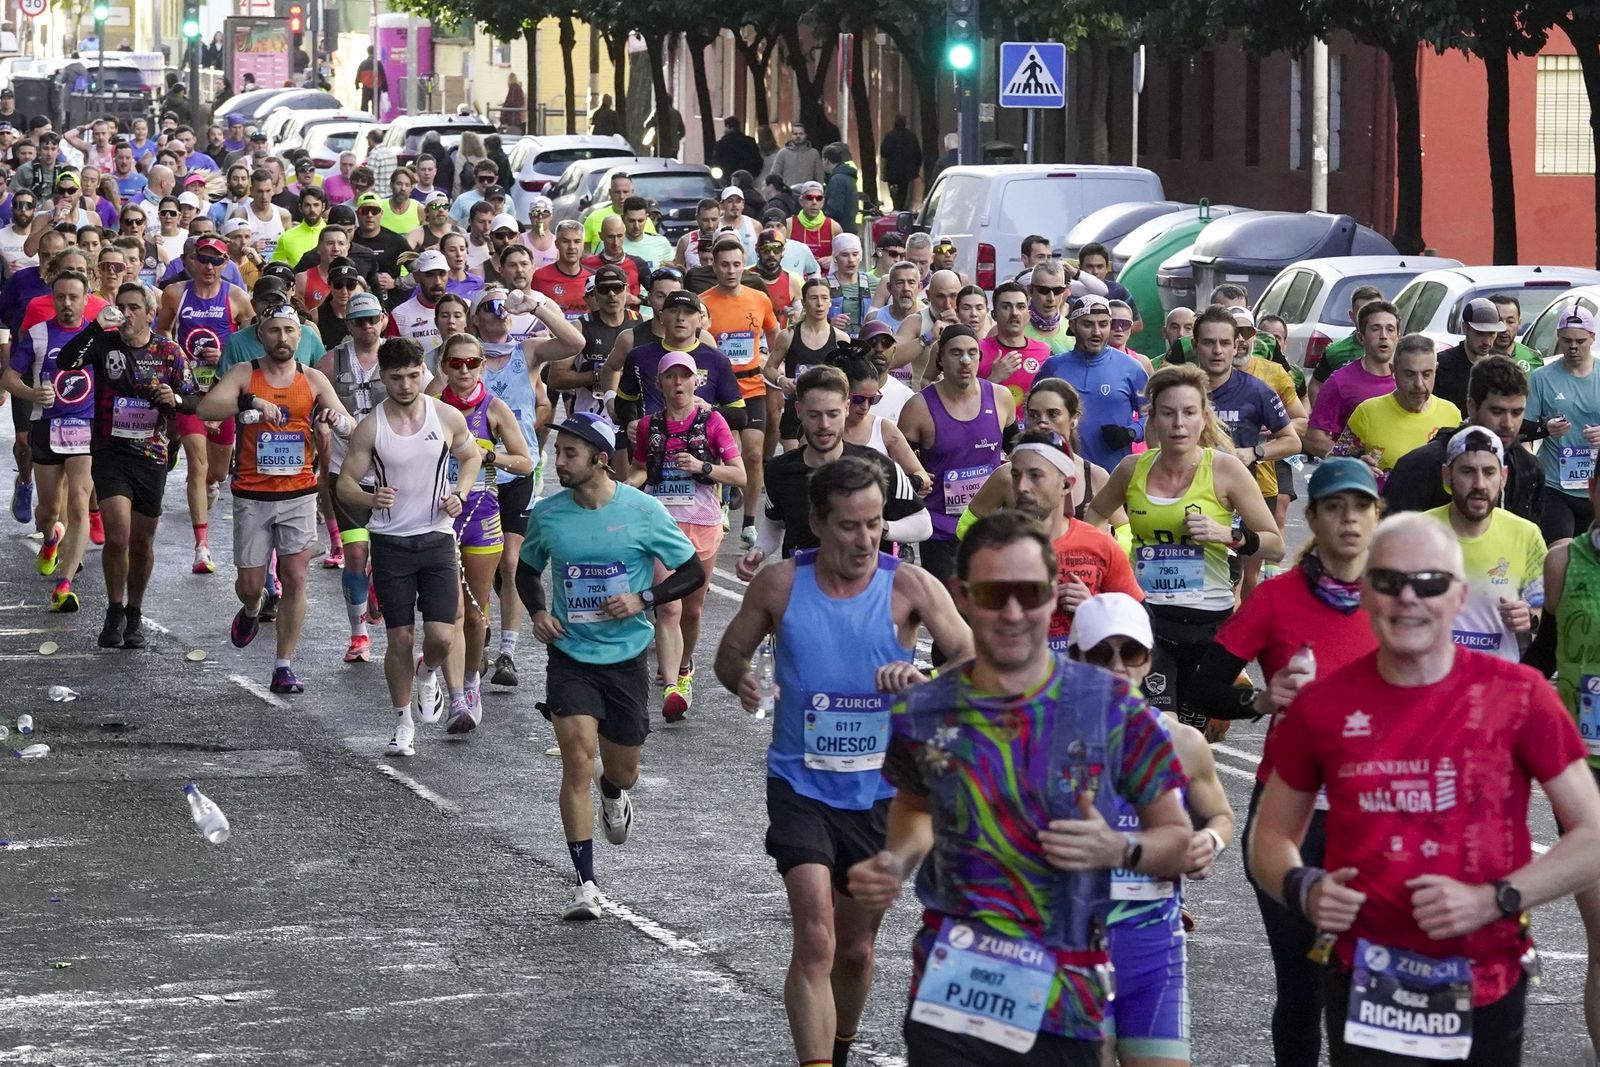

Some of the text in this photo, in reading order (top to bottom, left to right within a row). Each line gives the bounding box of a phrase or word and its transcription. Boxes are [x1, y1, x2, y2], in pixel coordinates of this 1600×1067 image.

[181, 306, 224, 319] Quintana
[257, 456, 304, 465] JESUS G.S.
[961, 466, 988, 478] ZURICH
[652, 484, 690, 494] MELANIE
[961, 483, 980, 492] 11003
[947, 494, 967, 505] NOE
[1159, 549, 1195, 557] ZURICH
[584, 565, 618, 576] ZURICH
[1159, 566, 1179, 575] 7963
[587, 585, 606, 593] 7924
[1152, 579, 1186, 590] JULIA
[1454, 635, 1493, 646] ZURICH
[835, 697, 882, 709] ZURICH
[836, 721, 862, 732] 6117
[816, 735, 877, 753] CHESCO
[1358, 787, 1433, 813] MÁLAGA
[978, 935, 1044, 965] ZURICH
[1396, 956, 1459, 978] ZURICH
[946, 982, 1016, 1020] PJOTR
[1359, 1000, 1461, 1034] RICHARD
